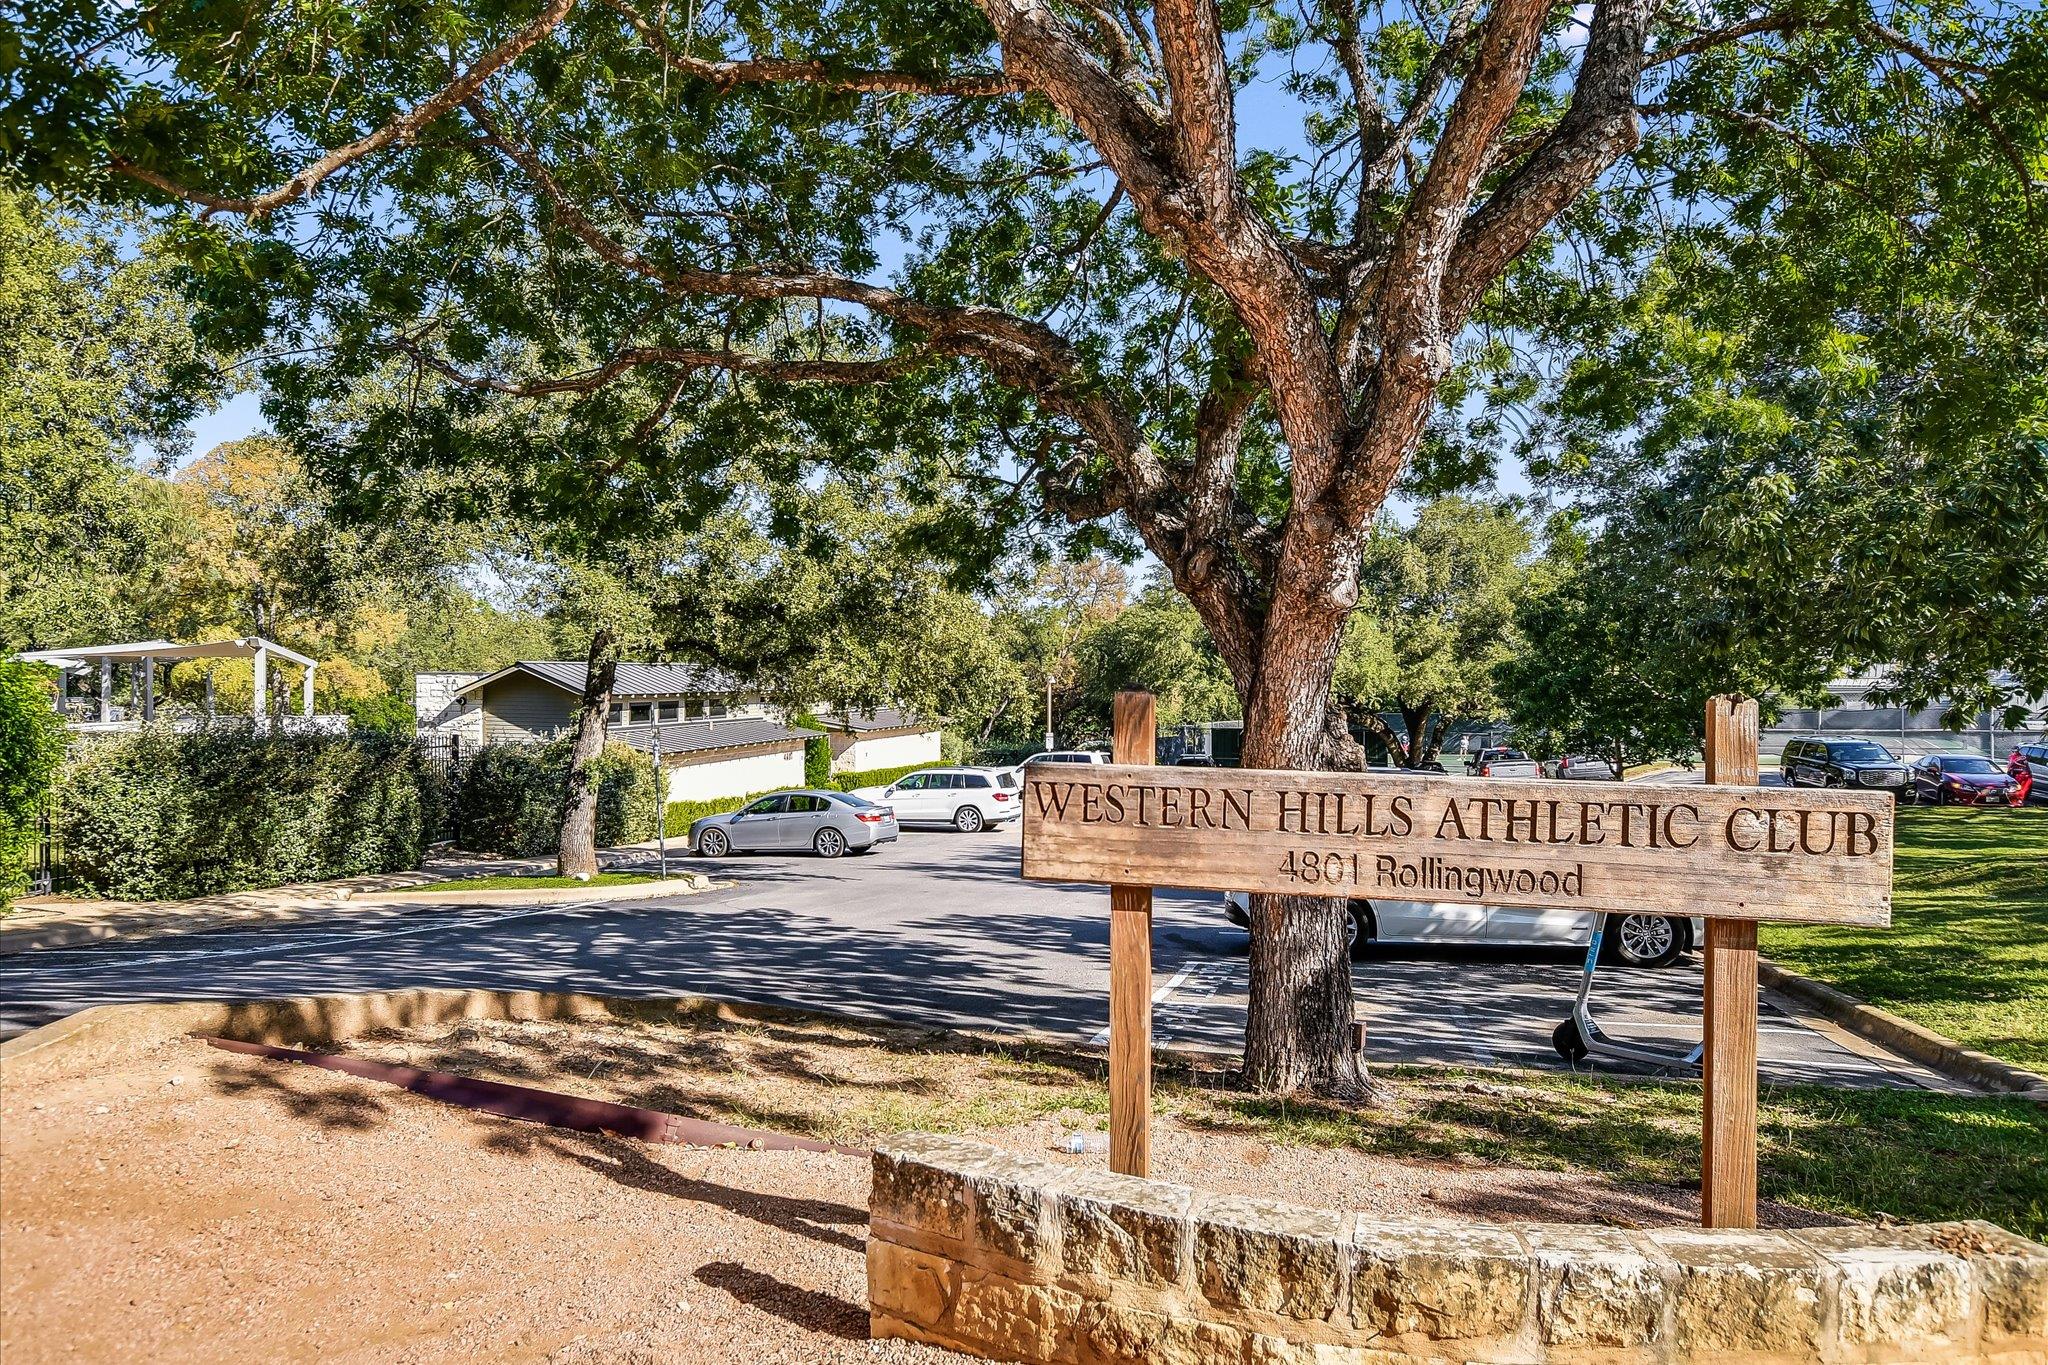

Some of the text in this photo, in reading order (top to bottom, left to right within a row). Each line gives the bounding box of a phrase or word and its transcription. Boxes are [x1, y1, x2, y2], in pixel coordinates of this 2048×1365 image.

[1030, 780, 1880, 858] WESTERN HILLS ATHLETIC CLUB
[1280, 850, 1583, 897] 4801 Rollingwood
